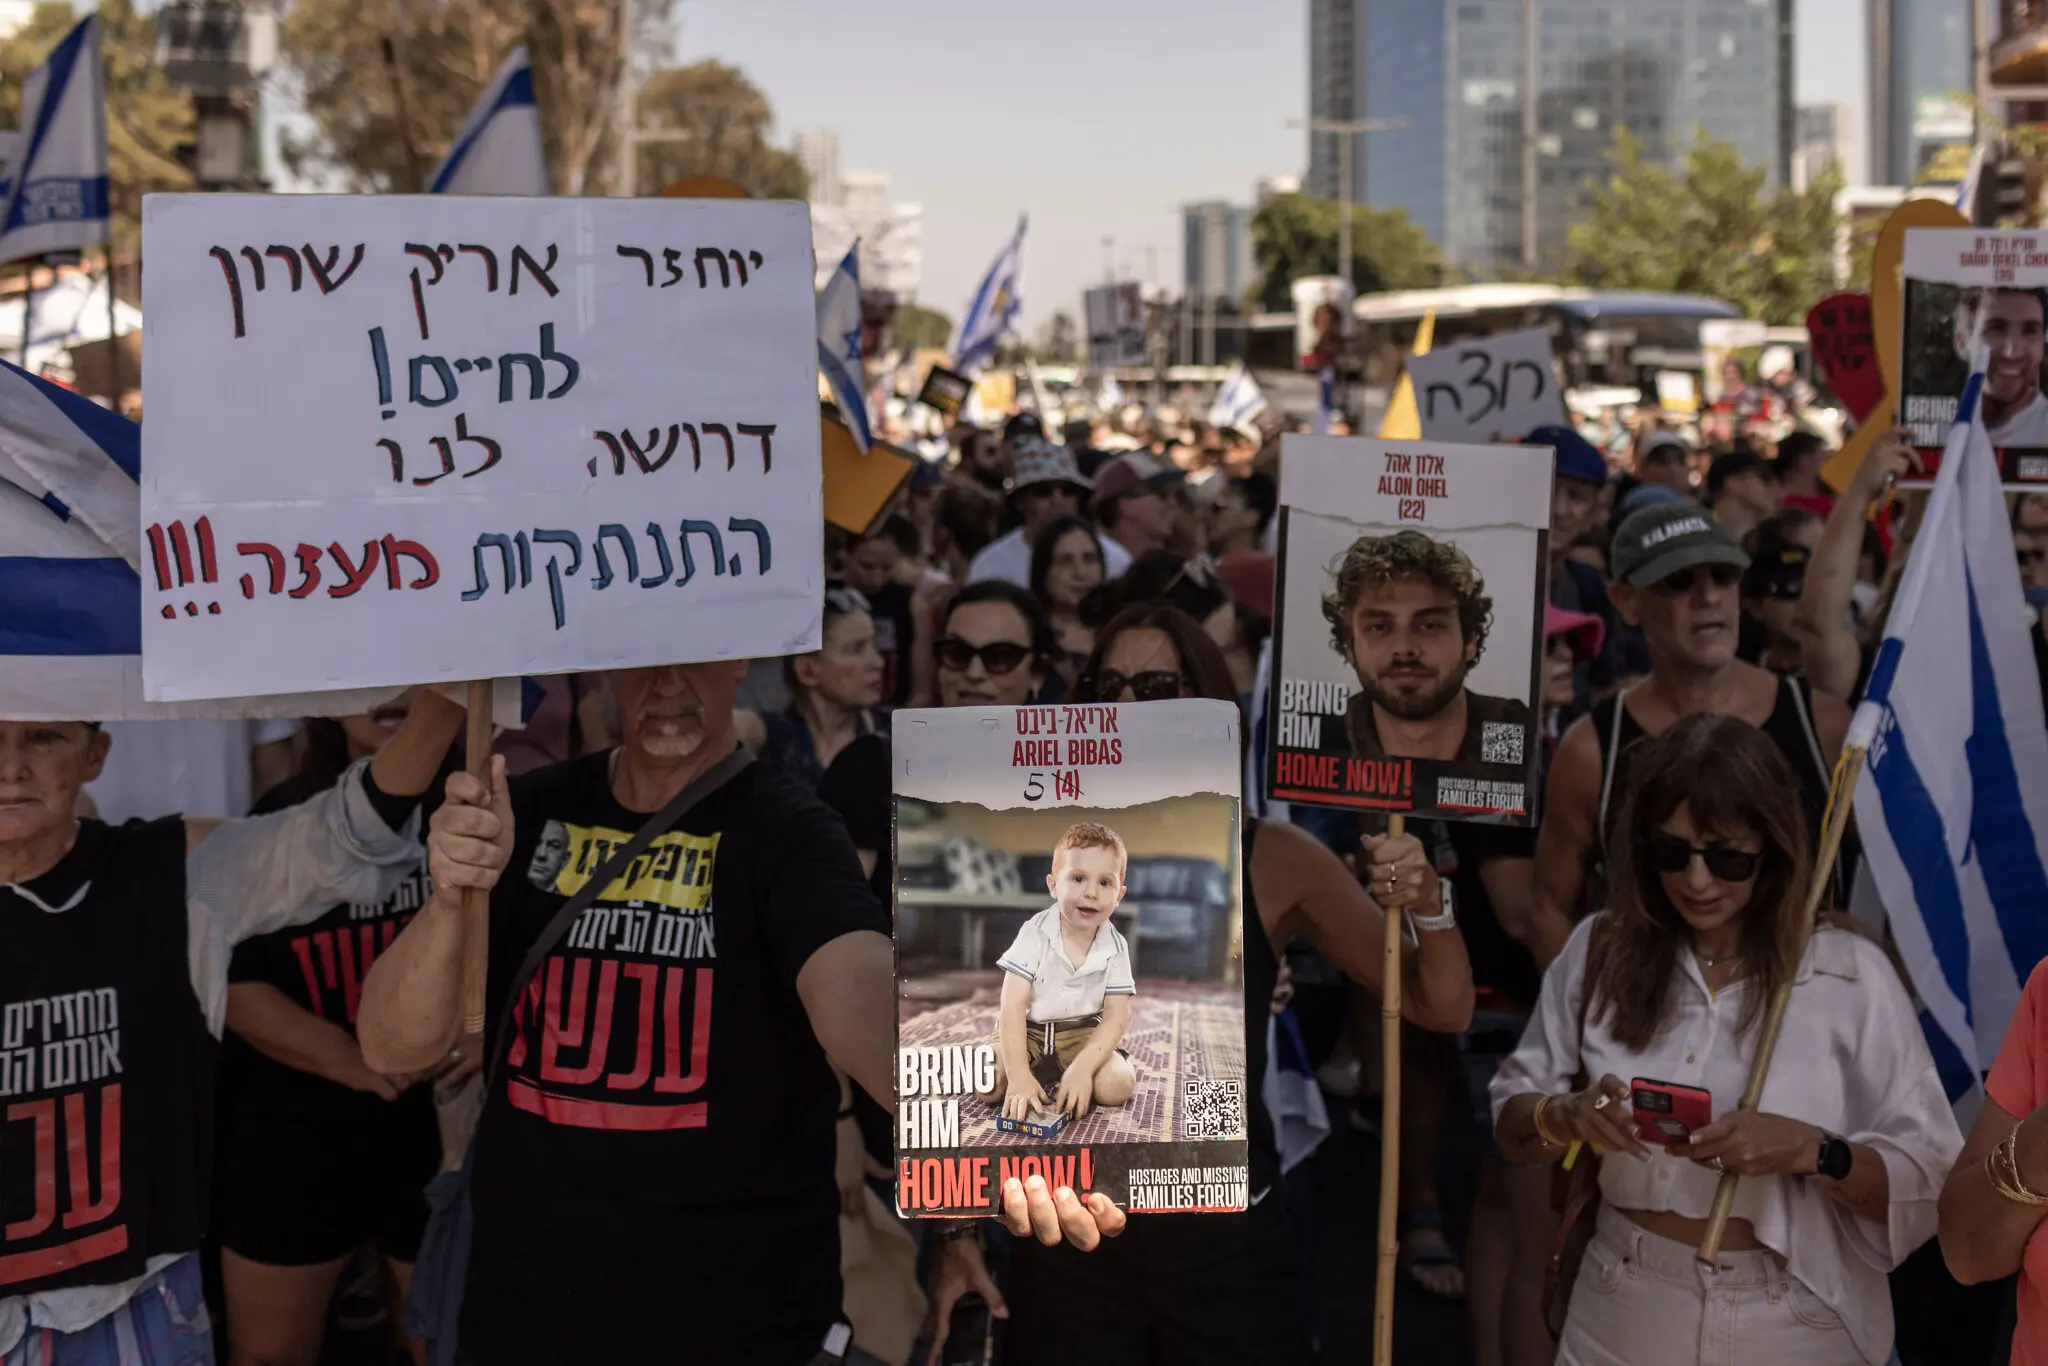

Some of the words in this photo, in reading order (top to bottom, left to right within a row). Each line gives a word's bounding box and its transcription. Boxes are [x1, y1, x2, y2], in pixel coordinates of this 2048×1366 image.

[209, 241, 366, 340] שרון
[404, 241, 559, 341] אריק
[377, 413, 503, 487] לנו
[587, 421, 778, 477] דרושה
[1384, 451, 1412, 474] אהל
[1416, 453, 1445, 476] אלון
[1377, 475, 1413, 497] ALON
[1416, 477, 1449, 499] OHEL
[1398, 498, 1426, 522] (22)
[460, 515, 773, 631] התנתקות
[1281, 679, 1348, 717] BRING
[1015, 707, 1058, 736] ביבס
[1062, 706, 1119, 735] אריאל
[1277, 713, 1321, 750] HIM
[1012, 739, 1064, 767] ARIEL
[1068, 738, 1123, 766] BIBAS
[1023, 772, 1045, 802] 5
[1276, 751, 1341, 790] HOME
[1345, 757, 1413, 798] NOW!
[1438, 776, 1475, 791] HOSTAGES
[1475, 779, 1491, 793] AND
[1491, 780, 1525, 796] MISSING
[1438, 789, 1485, 809] FAMILIES
[1486, 792, 1525, 812] FORUM
[651, 913, 717, 960] אותם
[3, 986, 119, 1050] מחזירים
[43, 1029, 124, 1091] אותם
[899, 1044, 996, 1096] BRING
[899, 1099, 960, 1150] HIM
[899, 1157, 990, 1210] HOME
[1129, 1168, 1180, 1185] HOSTAGES
[1181, 1167, 1202, 1184] AND
[1203, 1166, 1247, 1184] MISSING
[1129, 1184, 1194, 1209] FAMILIES
[1196, 1183, 1248, 1208] FORUM
